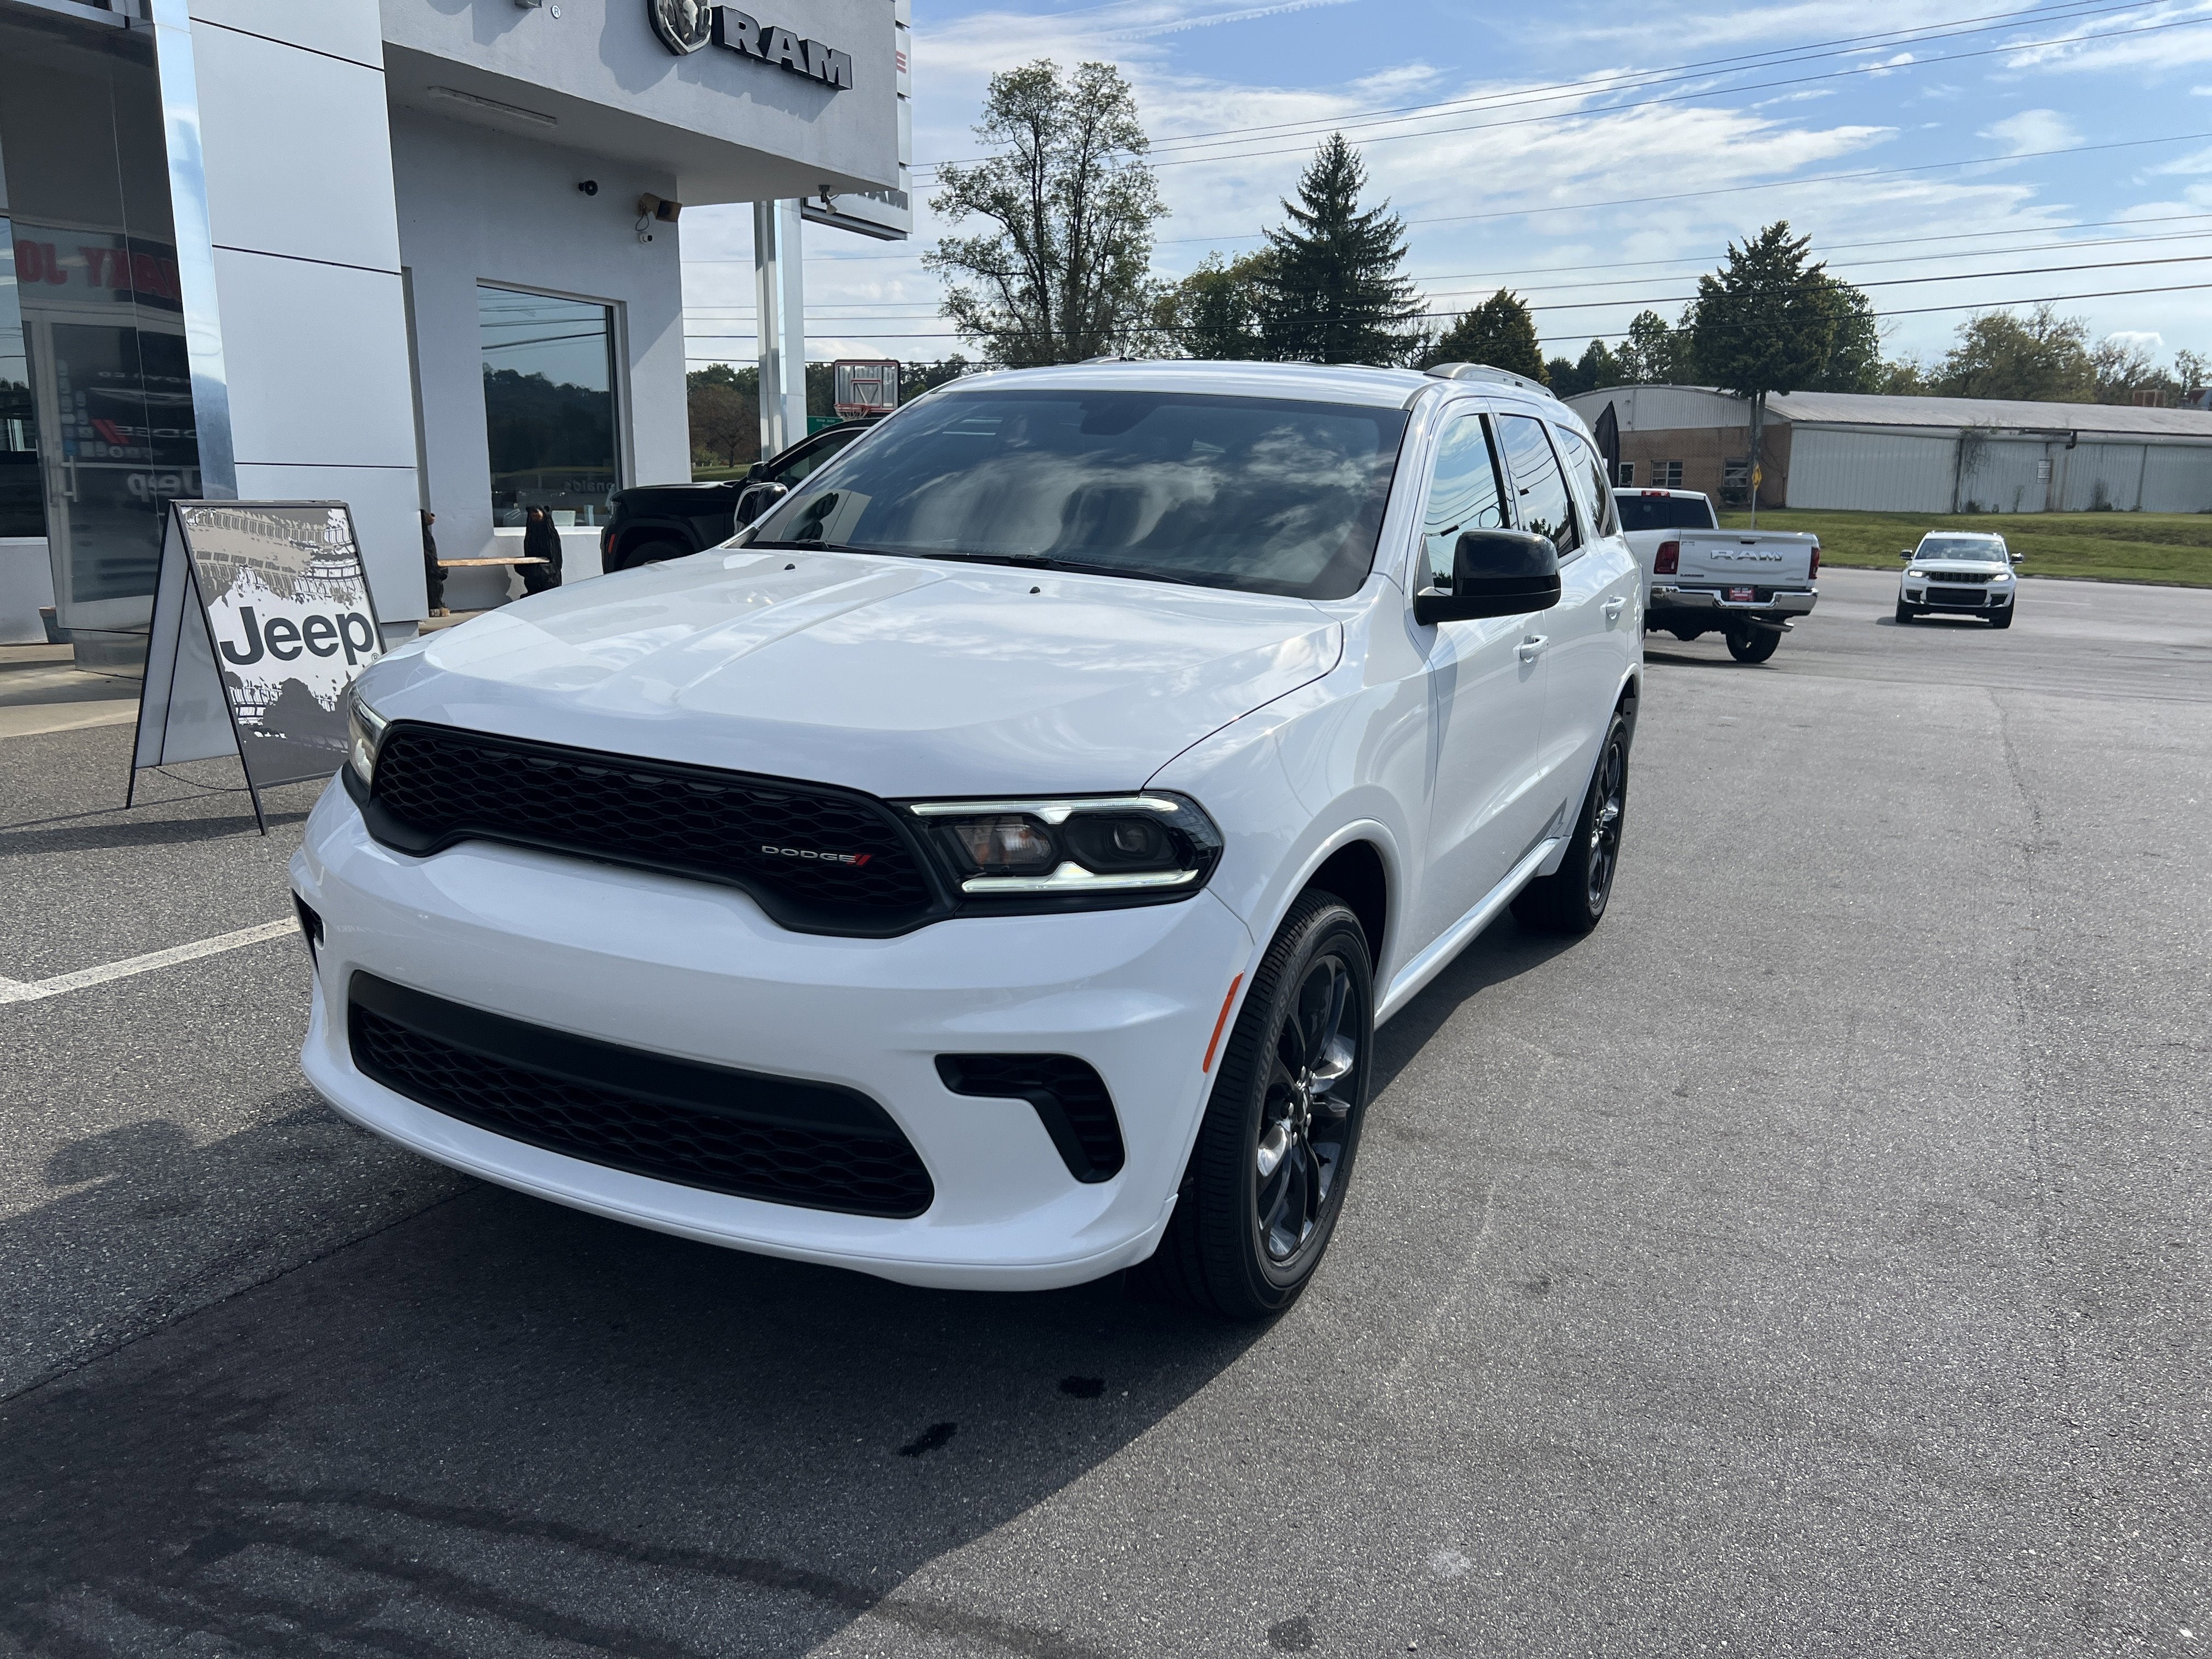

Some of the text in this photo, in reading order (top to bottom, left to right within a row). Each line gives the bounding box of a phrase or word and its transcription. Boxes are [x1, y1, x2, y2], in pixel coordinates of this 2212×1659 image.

[712, 5, 853, 90] RAM
[1711, 549, 1783, 562] RAM
[219, 606, 374, 665] Jeep
[761, 845, 856, 862] DODGE
